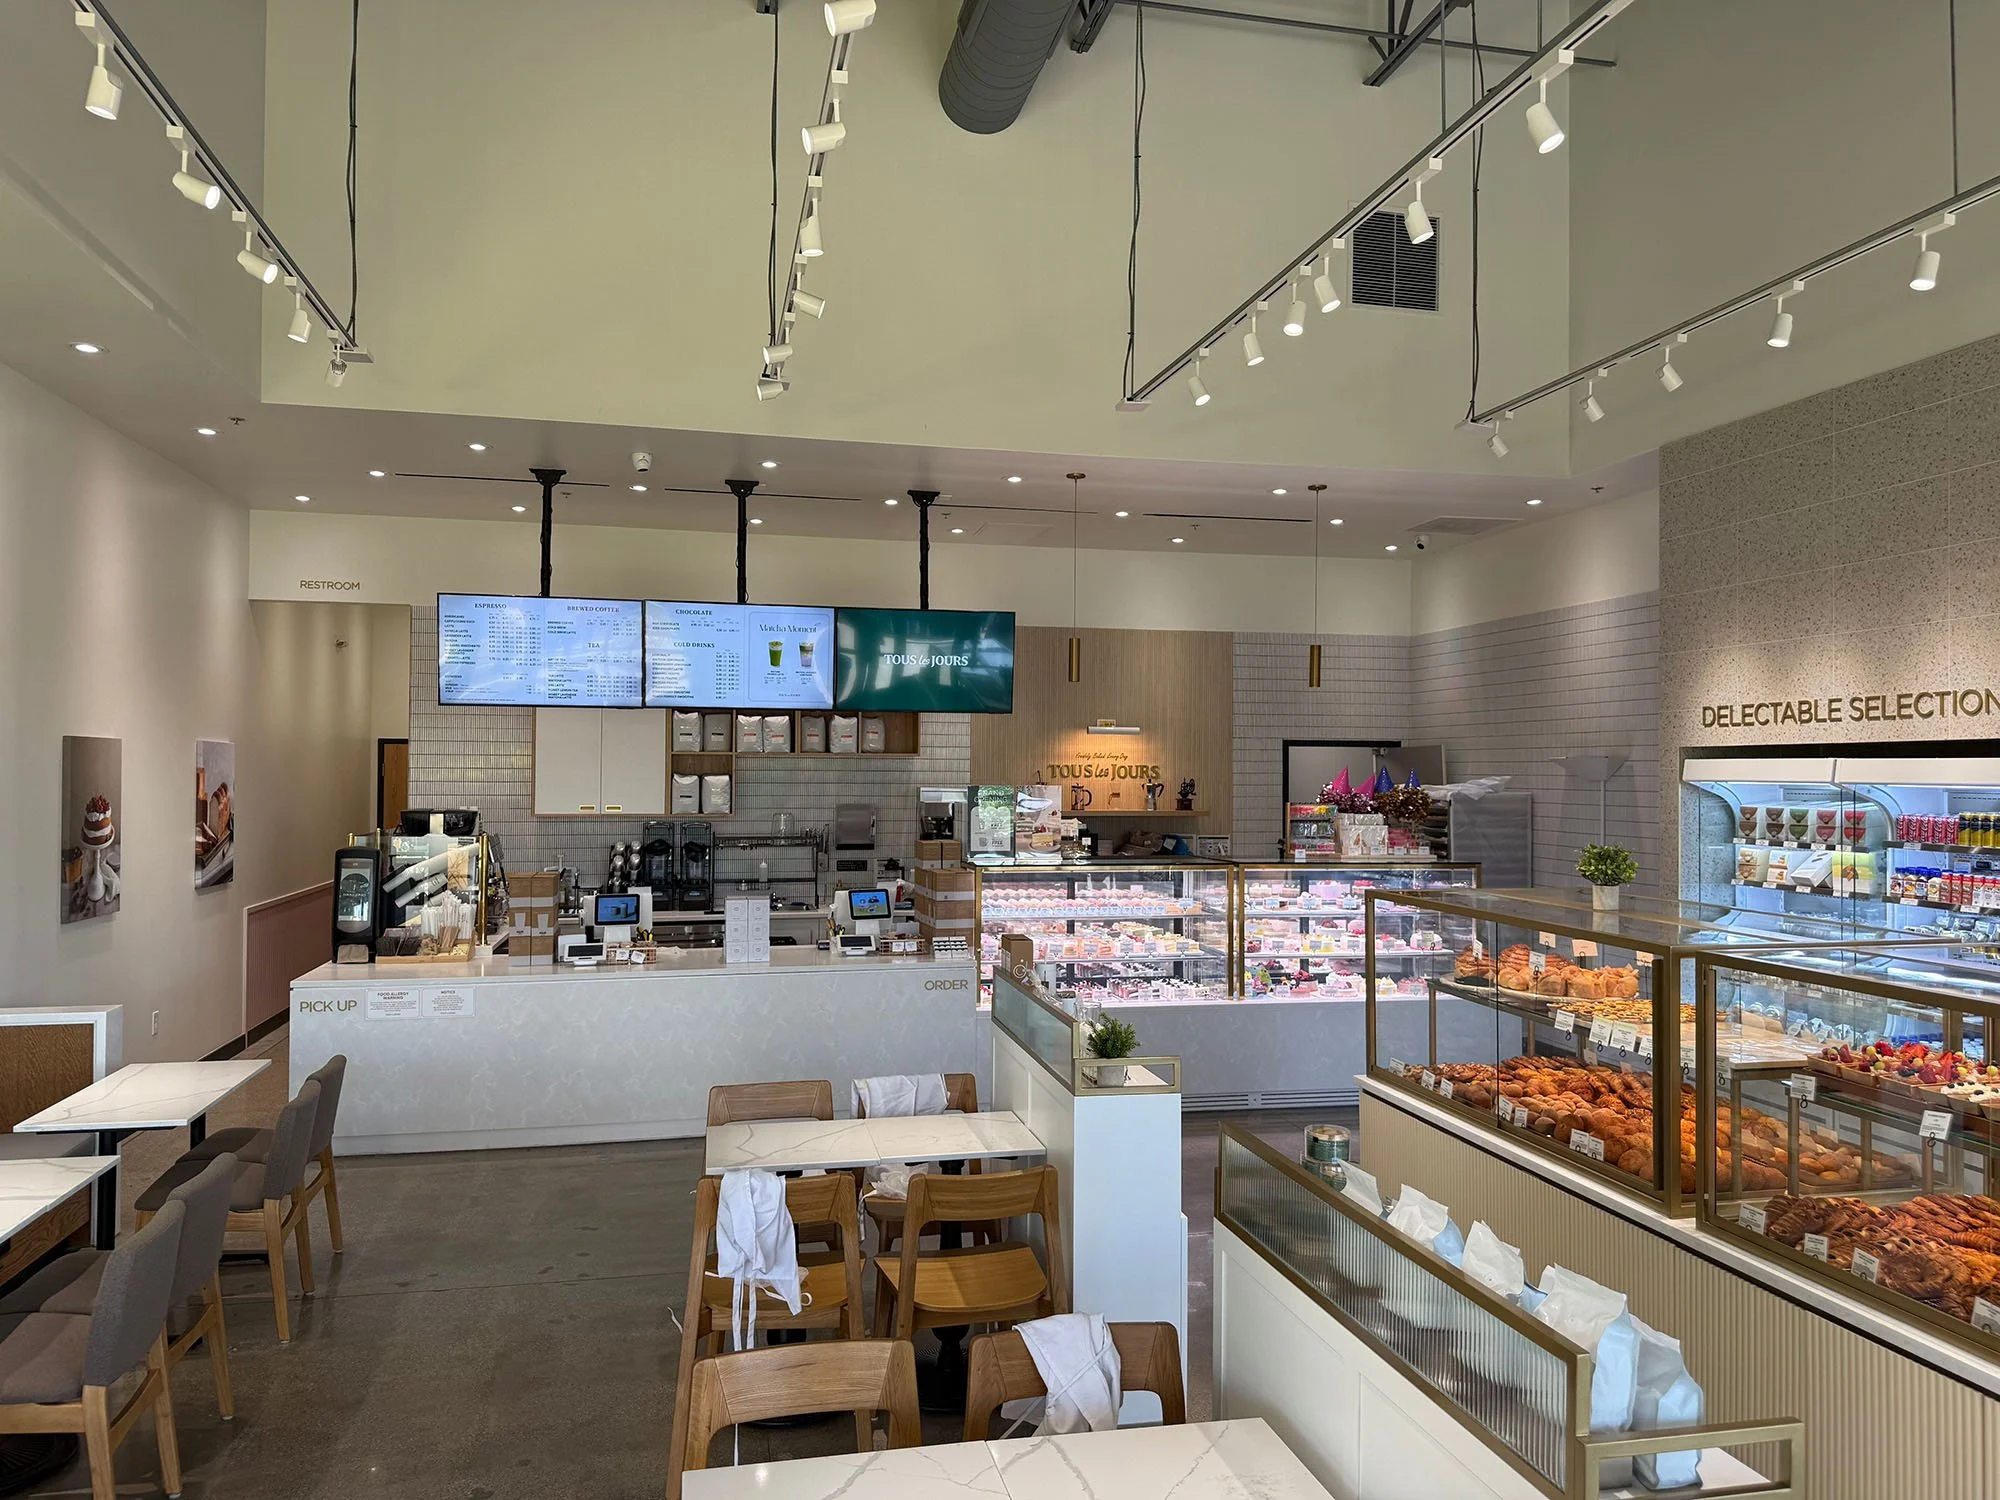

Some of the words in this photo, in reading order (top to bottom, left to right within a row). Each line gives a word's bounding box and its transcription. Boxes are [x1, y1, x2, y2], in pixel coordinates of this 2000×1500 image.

[300, 580, 360, 590] RESTROOM
[759, 624, 786, 633] Matcha
[788, 624, 817, 633] Moment
[884, 654, 917, 665] TOUS
[918, 654, 930, 665] les
[931, 655, 969, 667] JOURS
[1702, 698, 1842, 728] DELECTABLE
[1047, 764, 1093, 779] TOUS
[1094, 763, 1109, 778] les
[1110, 764, 1161, 781] JOURS
[924, 980, 968, 991] ORDER
[299, 1000, 333, 1013] PICK
[337, 1000, 358, 1011] UP
